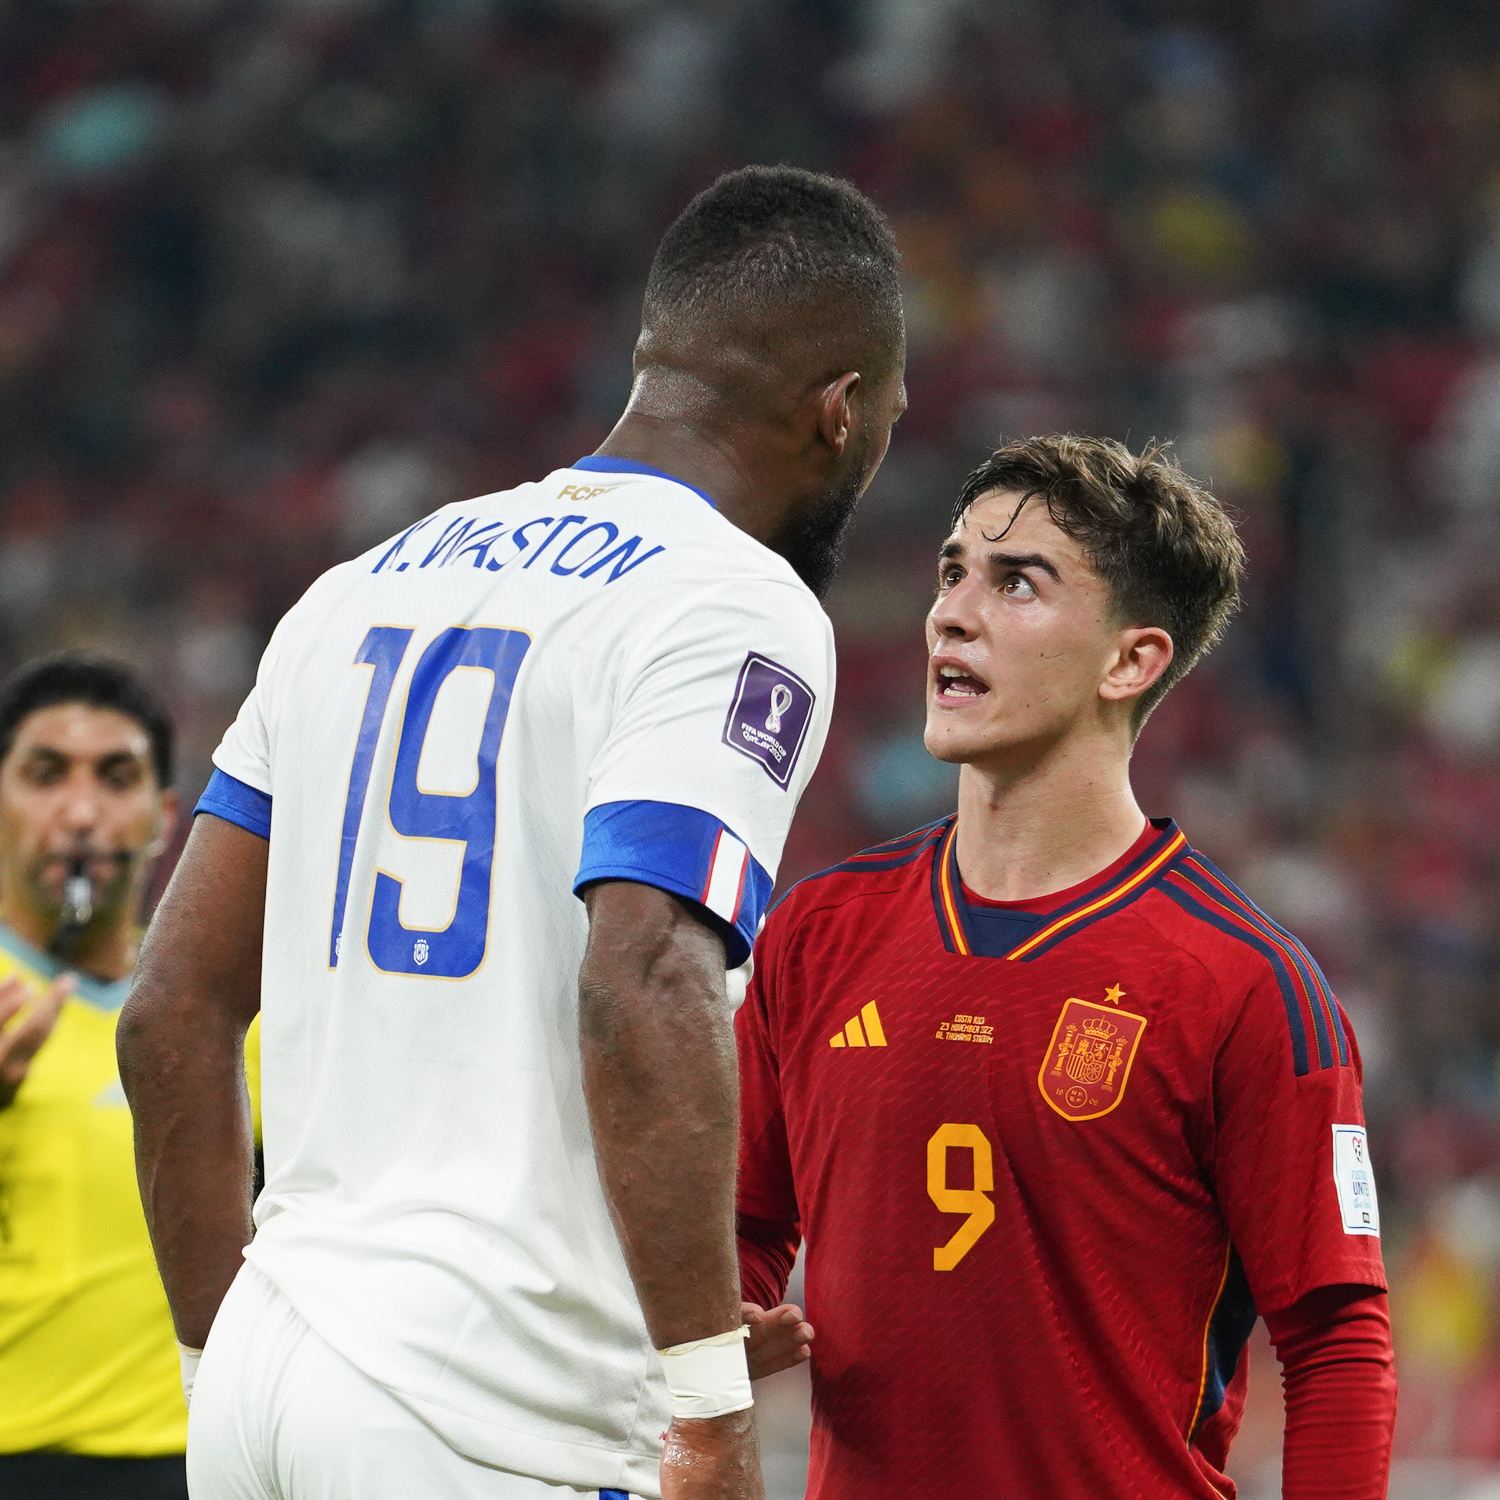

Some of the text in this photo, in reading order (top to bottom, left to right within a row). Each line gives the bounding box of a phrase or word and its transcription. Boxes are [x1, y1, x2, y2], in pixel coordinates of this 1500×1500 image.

[741, 722, 757, 736] FIFA
[757, 730, 780, 747] WORLD
[327, 623, 535, 982] 19
[939, 1022, 950, 1031] 23
[950, 1023, 980, 1034] NOVEMBER
[954, 1014, 973, 1024] COSTA
[935, 1031, 944, 1040] AL
[926, 1122, 996, 1271] 9
